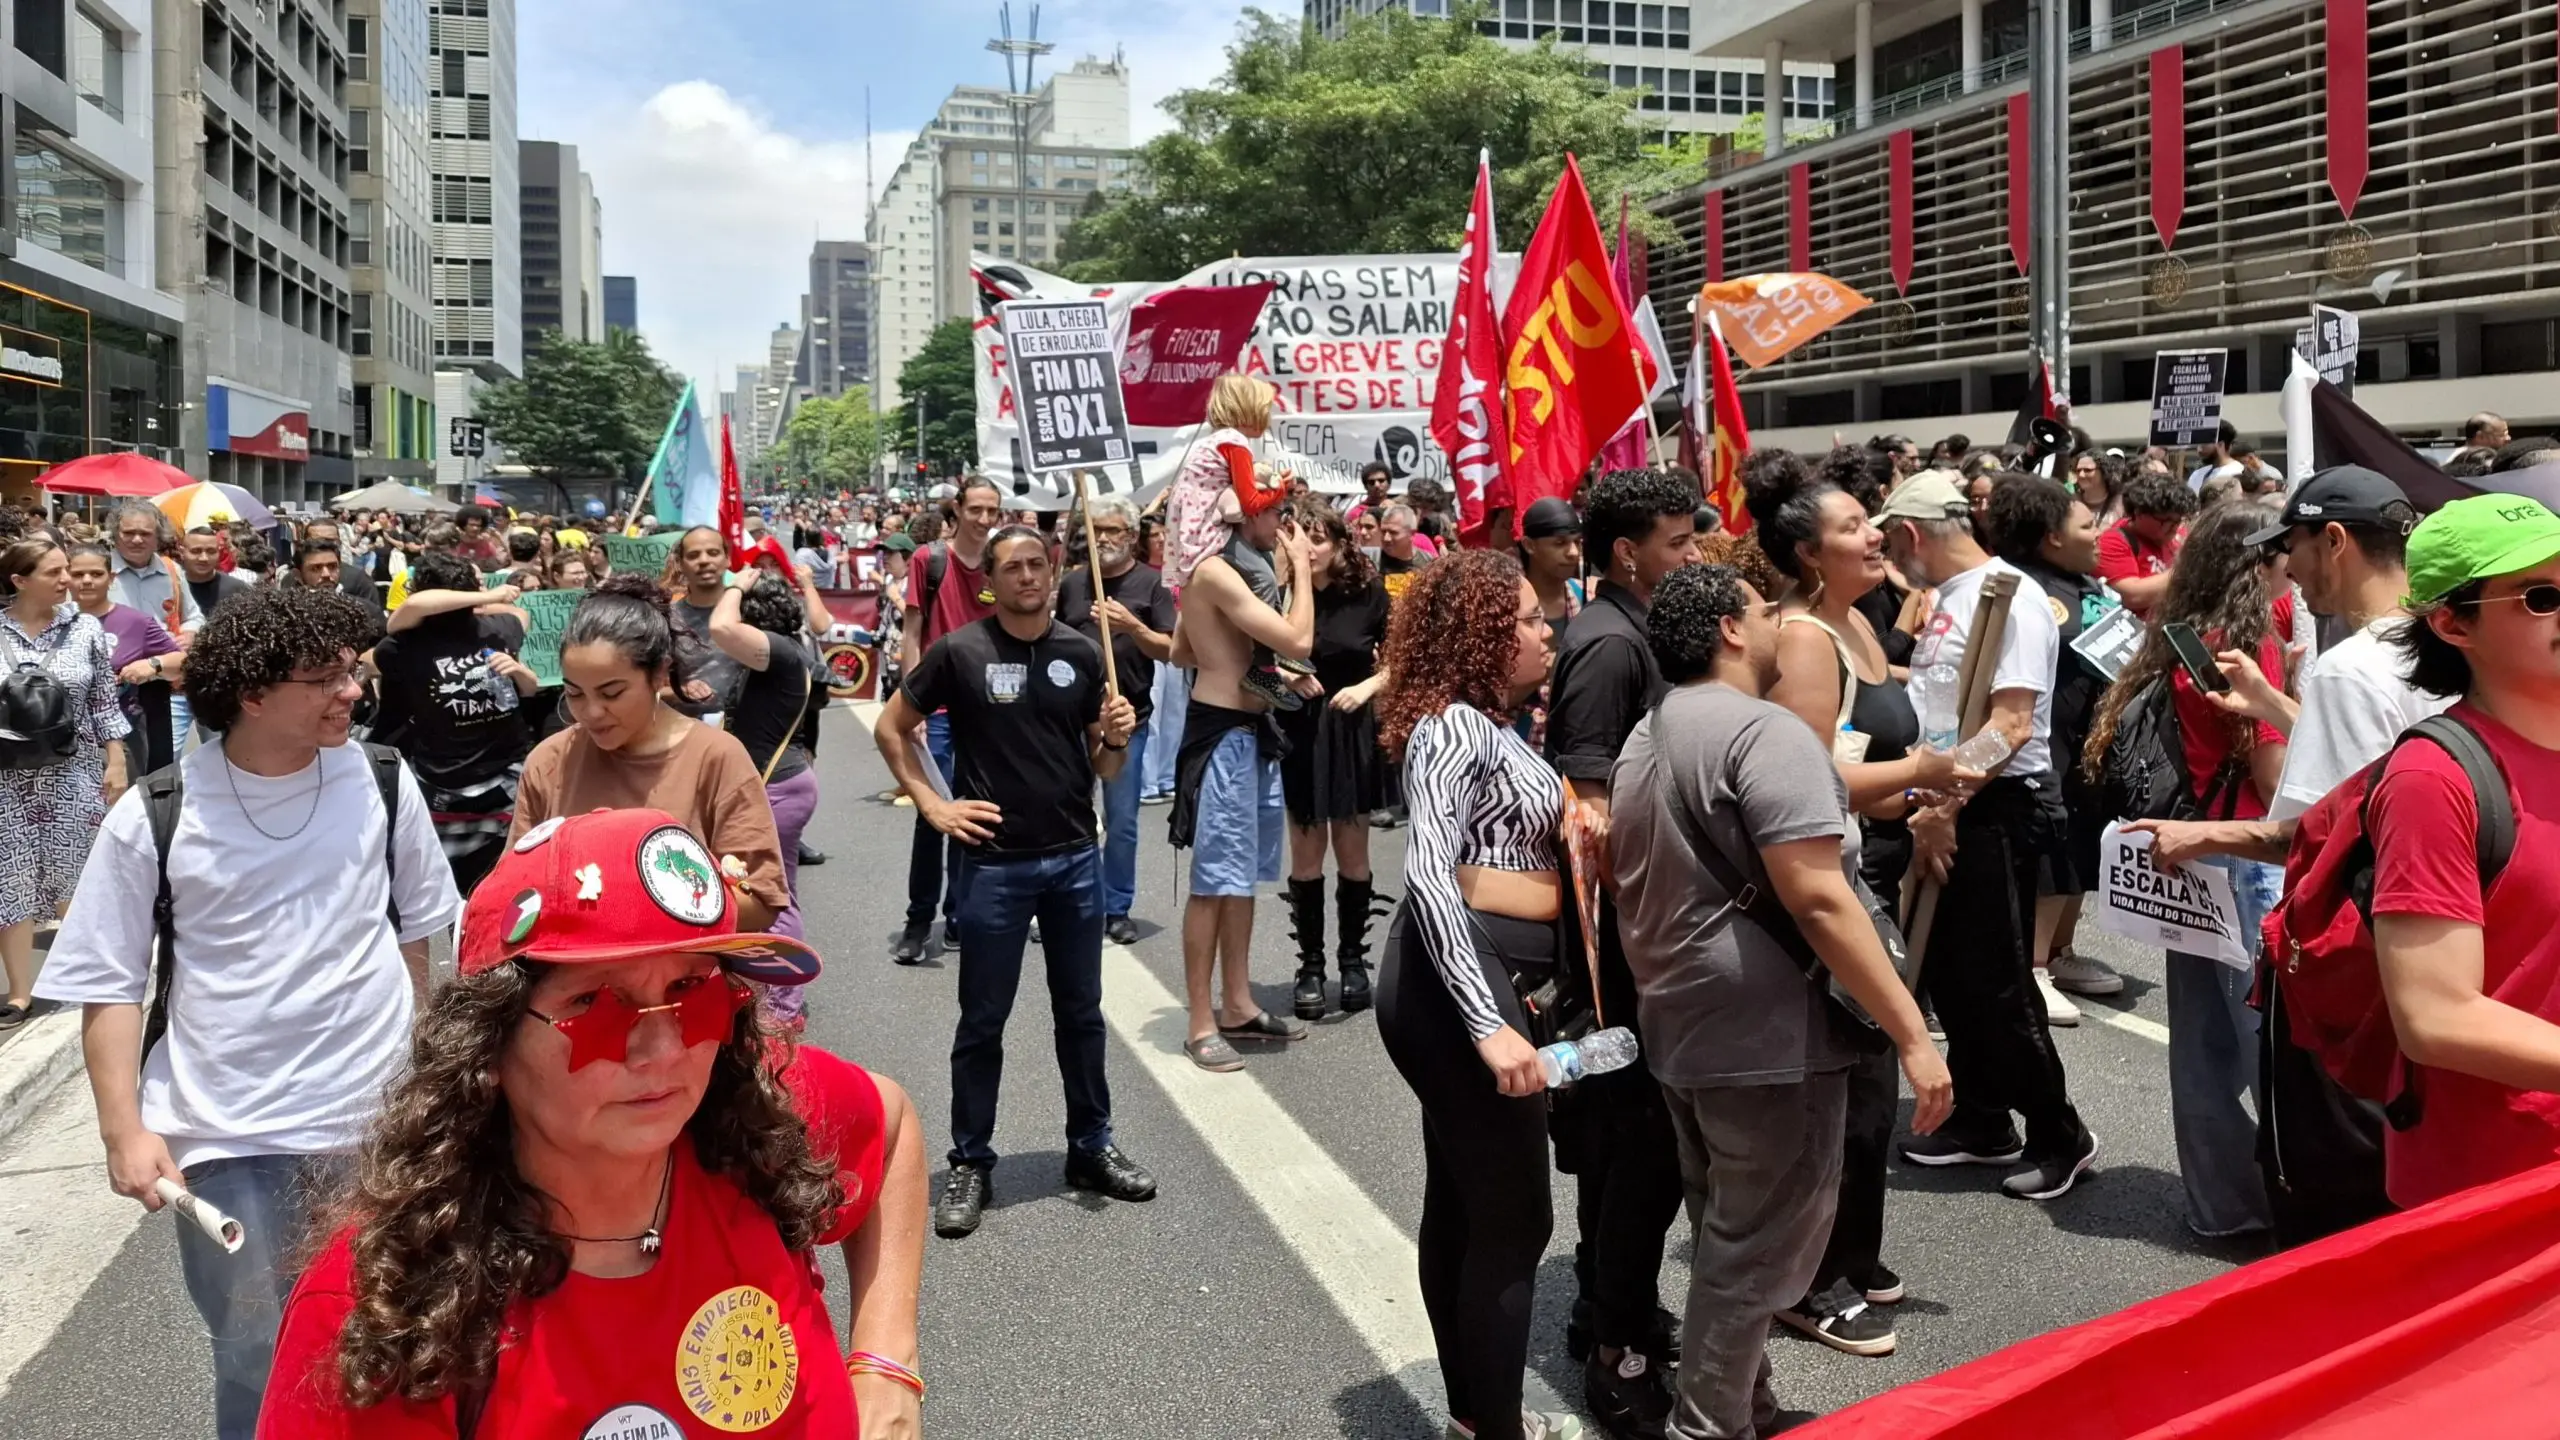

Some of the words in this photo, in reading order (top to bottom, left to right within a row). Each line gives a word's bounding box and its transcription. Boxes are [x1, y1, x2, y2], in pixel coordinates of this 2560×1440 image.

[1356, 266, 1436, 299] SEM
[1017, 310, 1057, 332] LULA,
[1059, 309, 1100, 328] CHEGA
[1327, 301, 1447, 337] SALARI
[1021, 336, 1036, 353] DE
[1039, 331, 1107, 352] ENROLAÇÃO!
[1165, 327, 1222, 358] FAÍSCA
[1273, 343, 1293, 375] E
[1293, 340, 1405, 374] GREVE
[1415, 339, 1446, 370] G
[1030, 359, 1072, 392] FIM
[1075, 357, 1105, 389] DA
[1268, 378, 1358, 414] RTES
[1367, 379, 1406, 410] DE
[1415, 377, 1436, 408] L
[1035, 396, 1056, 442] ESCALA
[1053, 393, 1113, 439] 6X1
[1262, 420, 1337, 456] AÍSCA
[531, 606, 573, 631] ALIST
[444, 698, 495, 717] TIBUR
[2110, 865, 2193, 905] ESCALA
[2112, 893, 2134, 909] VIDA
[2136, 899, 2162, 917] ALÉM
[2165, 907, 2179, 921] DO
[686, 1290, 761, 1356] EMPREGO
[683, 1365, 717, 1415] MAIS
[703, 1352, 723, 1401] SONHO
[742, 1407, 771, 1427] PRA
[774, 1322, 798, 1413] JUVENTUDE
[617, 1414, 633, 1425] VAT
[650, 1422, 671, 1438] DA
